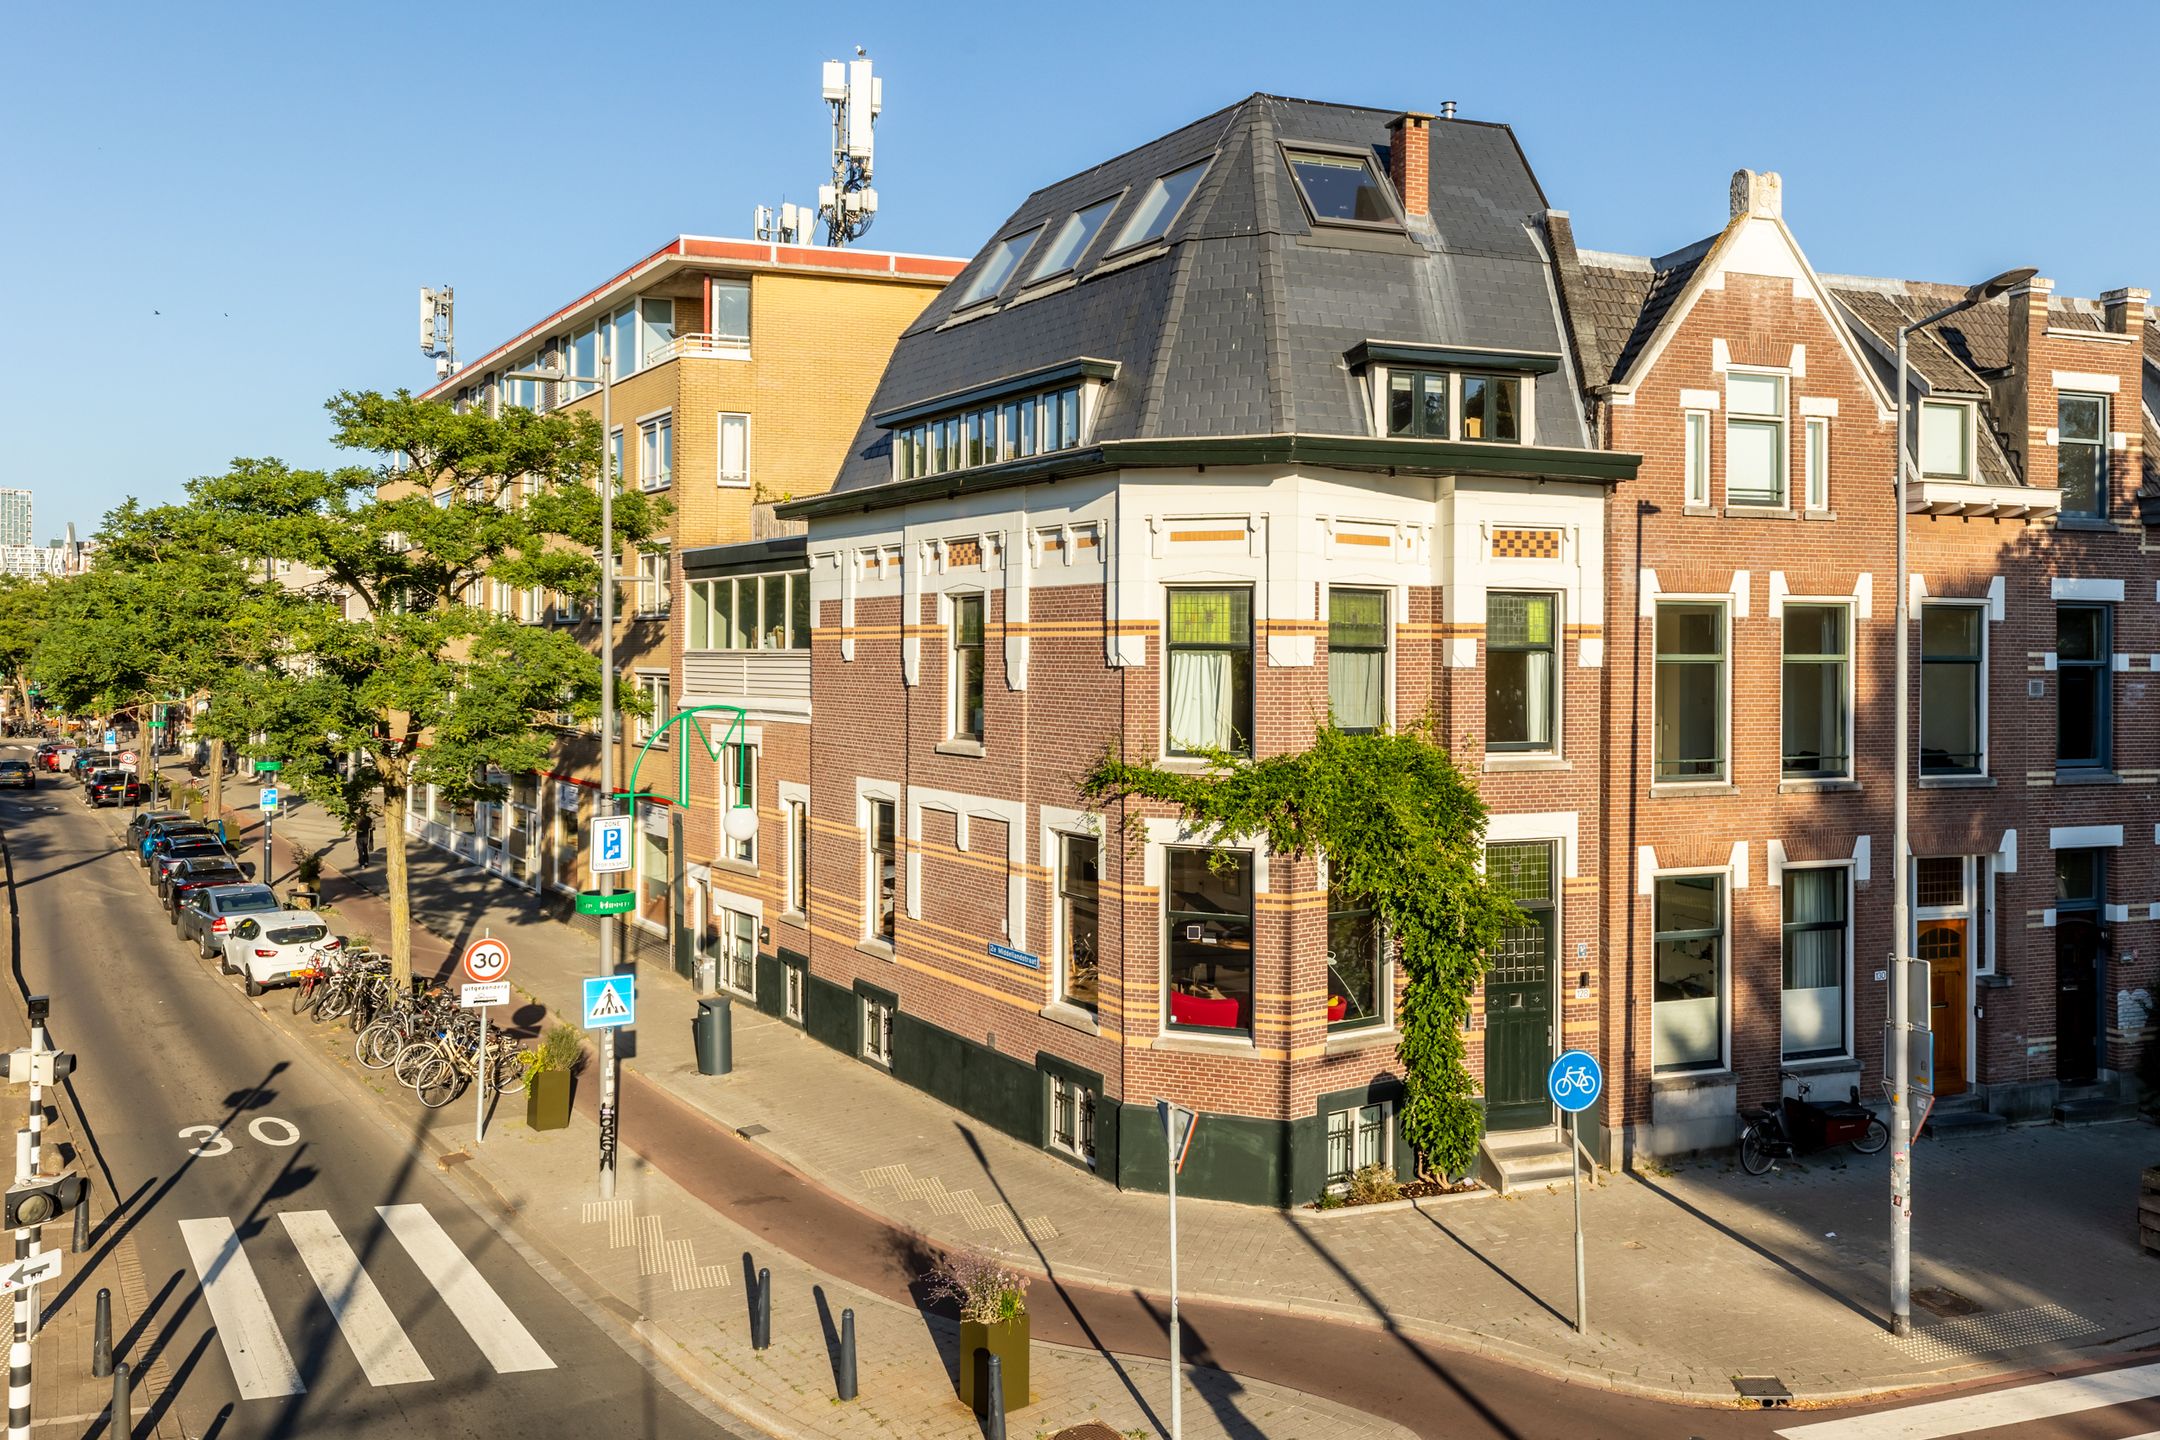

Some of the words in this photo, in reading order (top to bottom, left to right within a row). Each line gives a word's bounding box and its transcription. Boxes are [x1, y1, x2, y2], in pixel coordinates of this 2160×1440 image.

[604, 820, 620, 828] ZONE
[606, 830, 618, 848] P
[474, 952, 502, 969] 30
[1577, 989, 1589, 998] 128
[178, 1116, 301, 1158] 30
